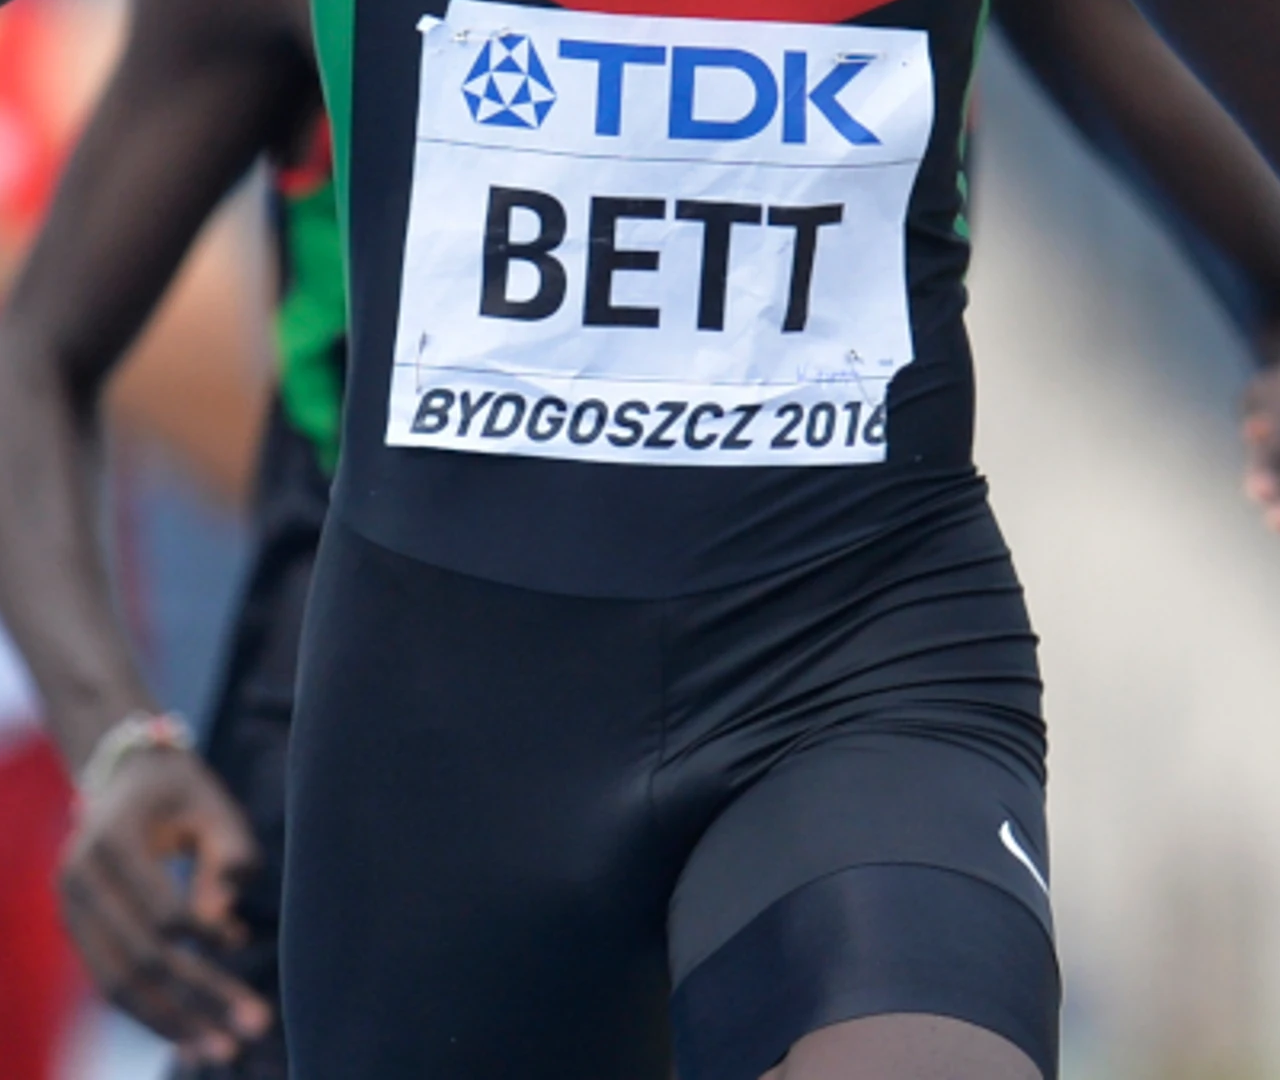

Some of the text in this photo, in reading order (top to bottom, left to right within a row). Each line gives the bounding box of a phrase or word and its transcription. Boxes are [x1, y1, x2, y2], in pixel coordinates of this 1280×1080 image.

[558, 39, 882, 146] TDK
[478, 185, 845, 334] BETT
[411, 387, 888, 452] BYDGOSZCZ 2016
